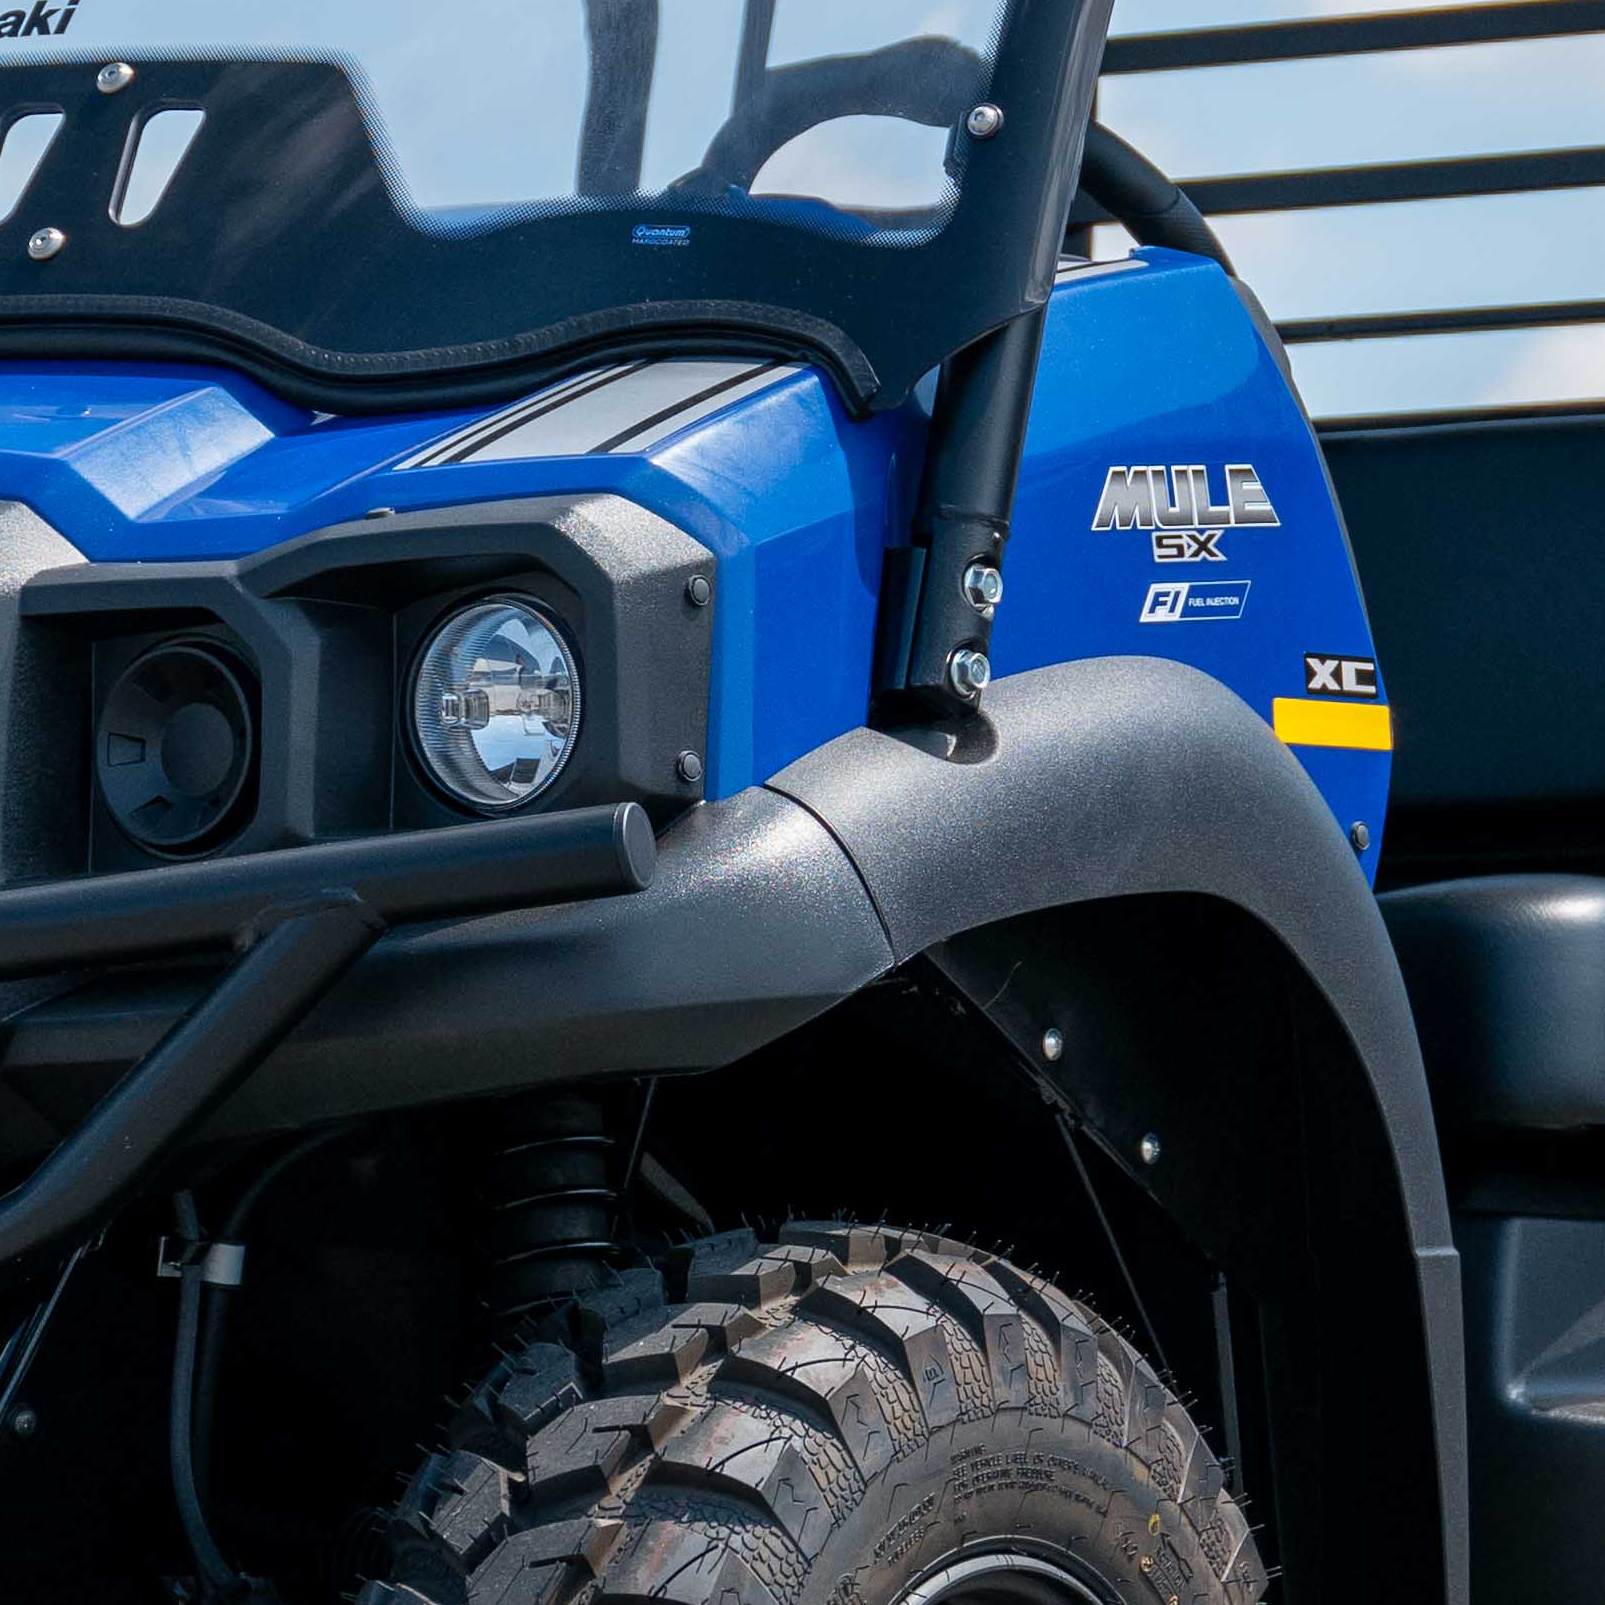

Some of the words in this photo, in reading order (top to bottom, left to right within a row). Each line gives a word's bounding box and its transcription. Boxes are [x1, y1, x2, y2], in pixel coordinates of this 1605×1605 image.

[1091, 464, 1281, 531] MULE
[1151, 529, 1228, 564] SX
[1146, 589, 1182, 615] FI
[1187, 597, 1205, 607] FUEL
[1206, 596, 1240, 607] INJECTION
[1306, 657, 1377, 695] XC
